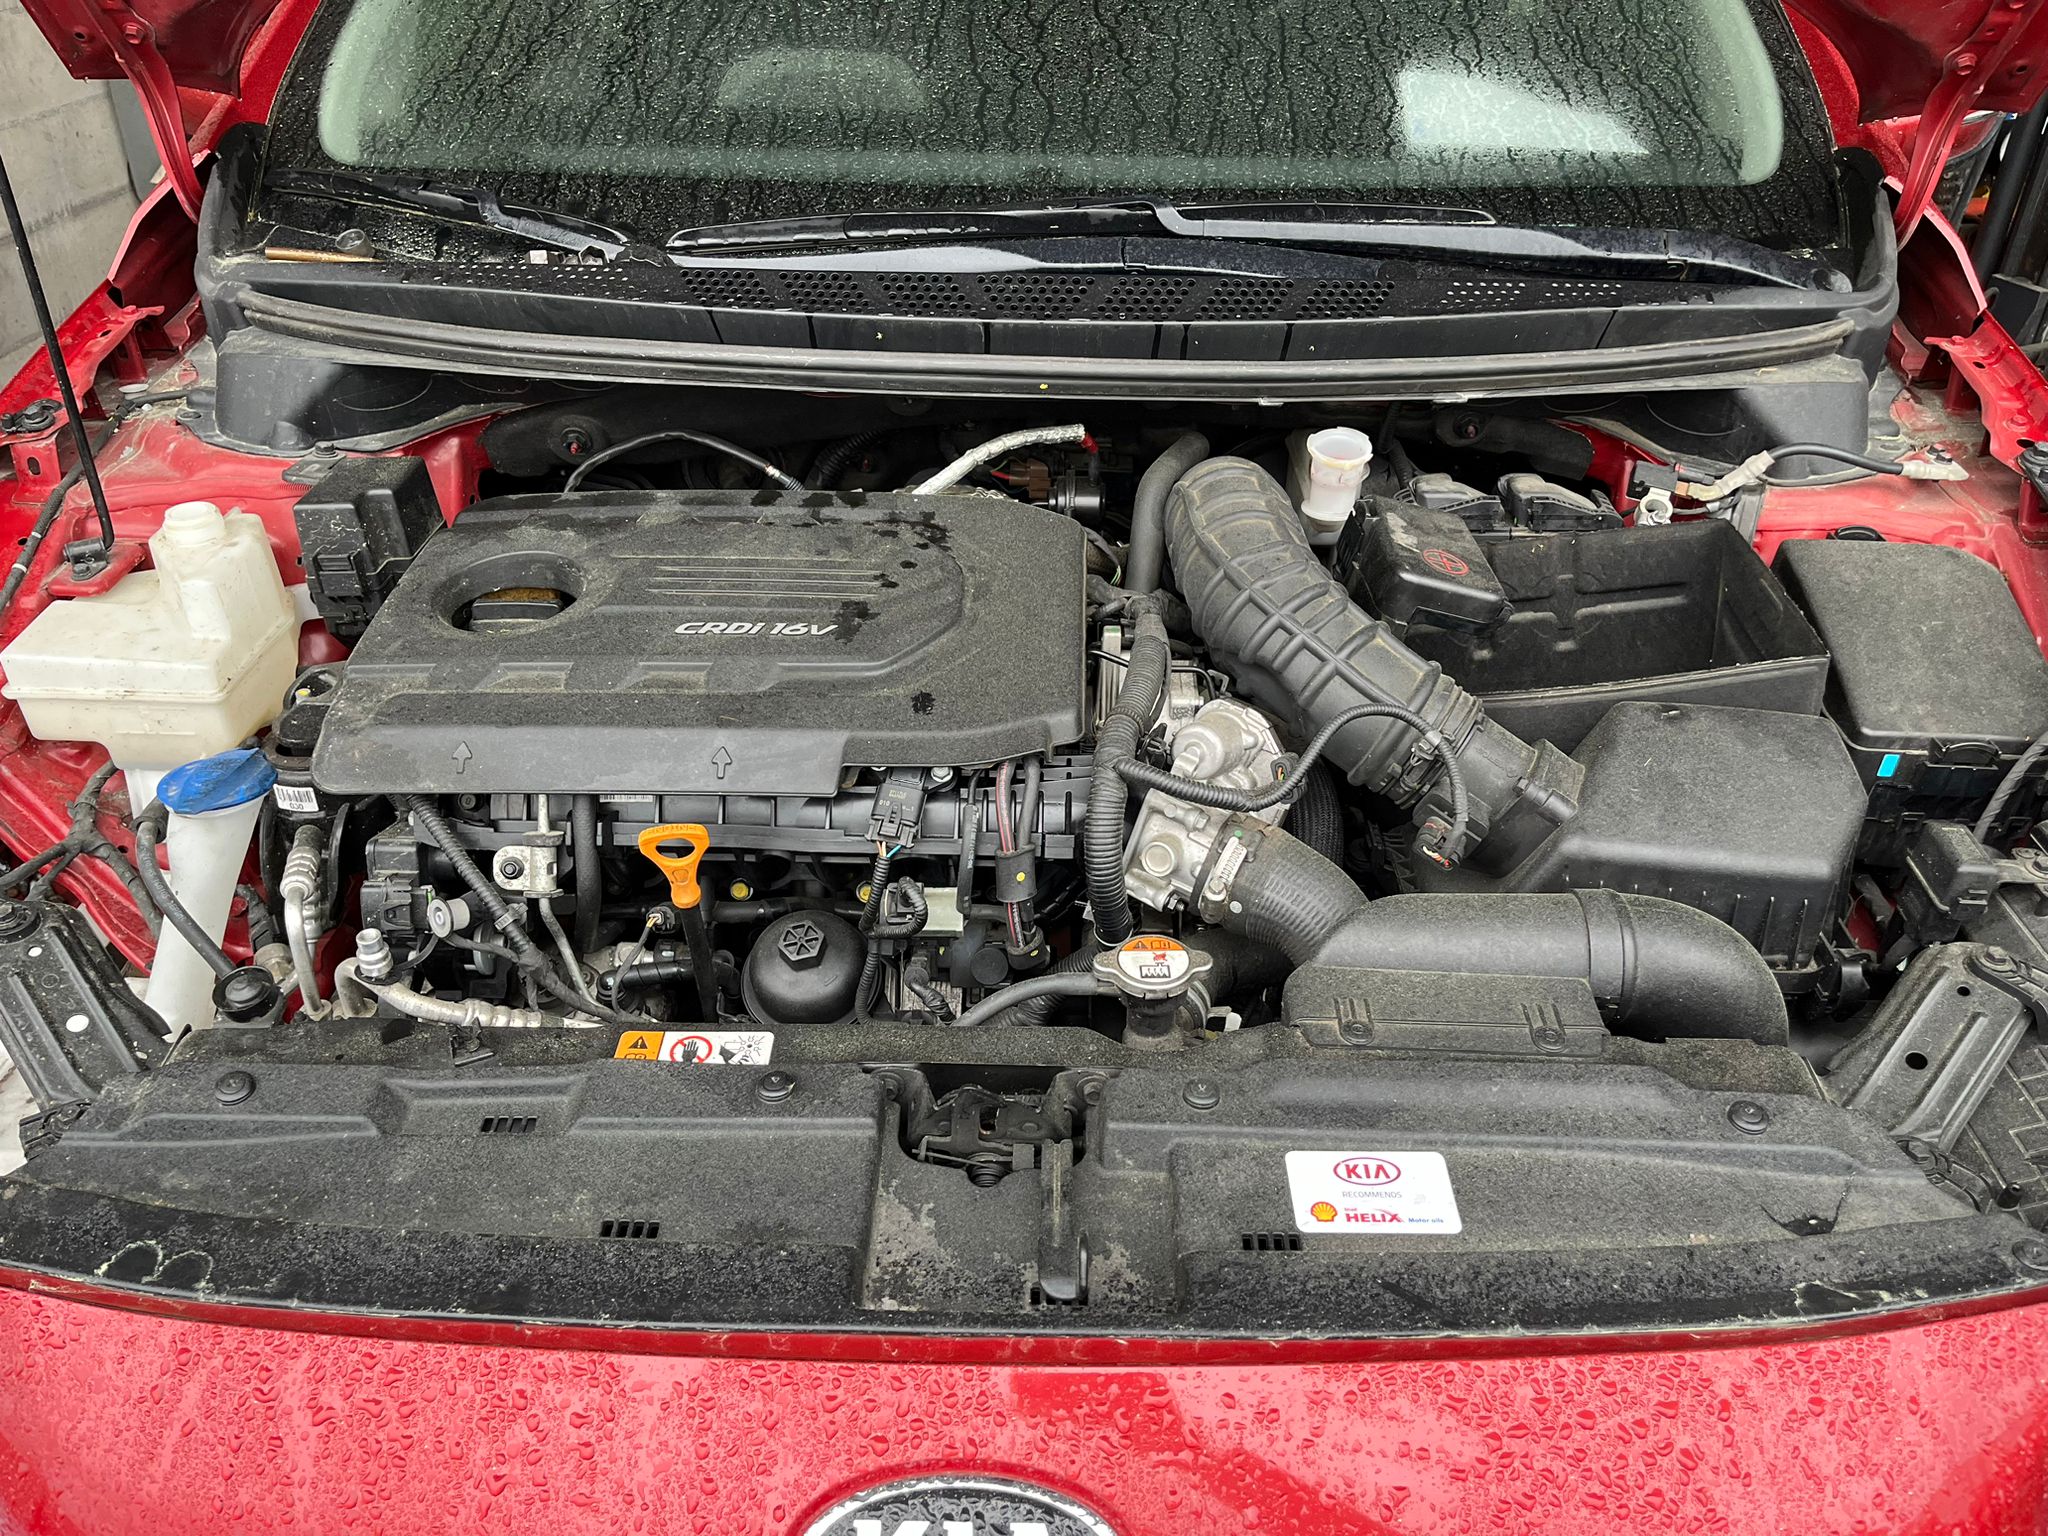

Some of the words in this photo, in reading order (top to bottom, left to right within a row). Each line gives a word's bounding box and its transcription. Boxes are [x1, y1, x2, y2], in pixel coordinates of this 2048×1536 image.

[1344, 1163, 1391, 1179] KIA
[1342, 1190, 1403, 1199] RECOMMENDS
[1345, 1212, 1403, 1223] HELIX
